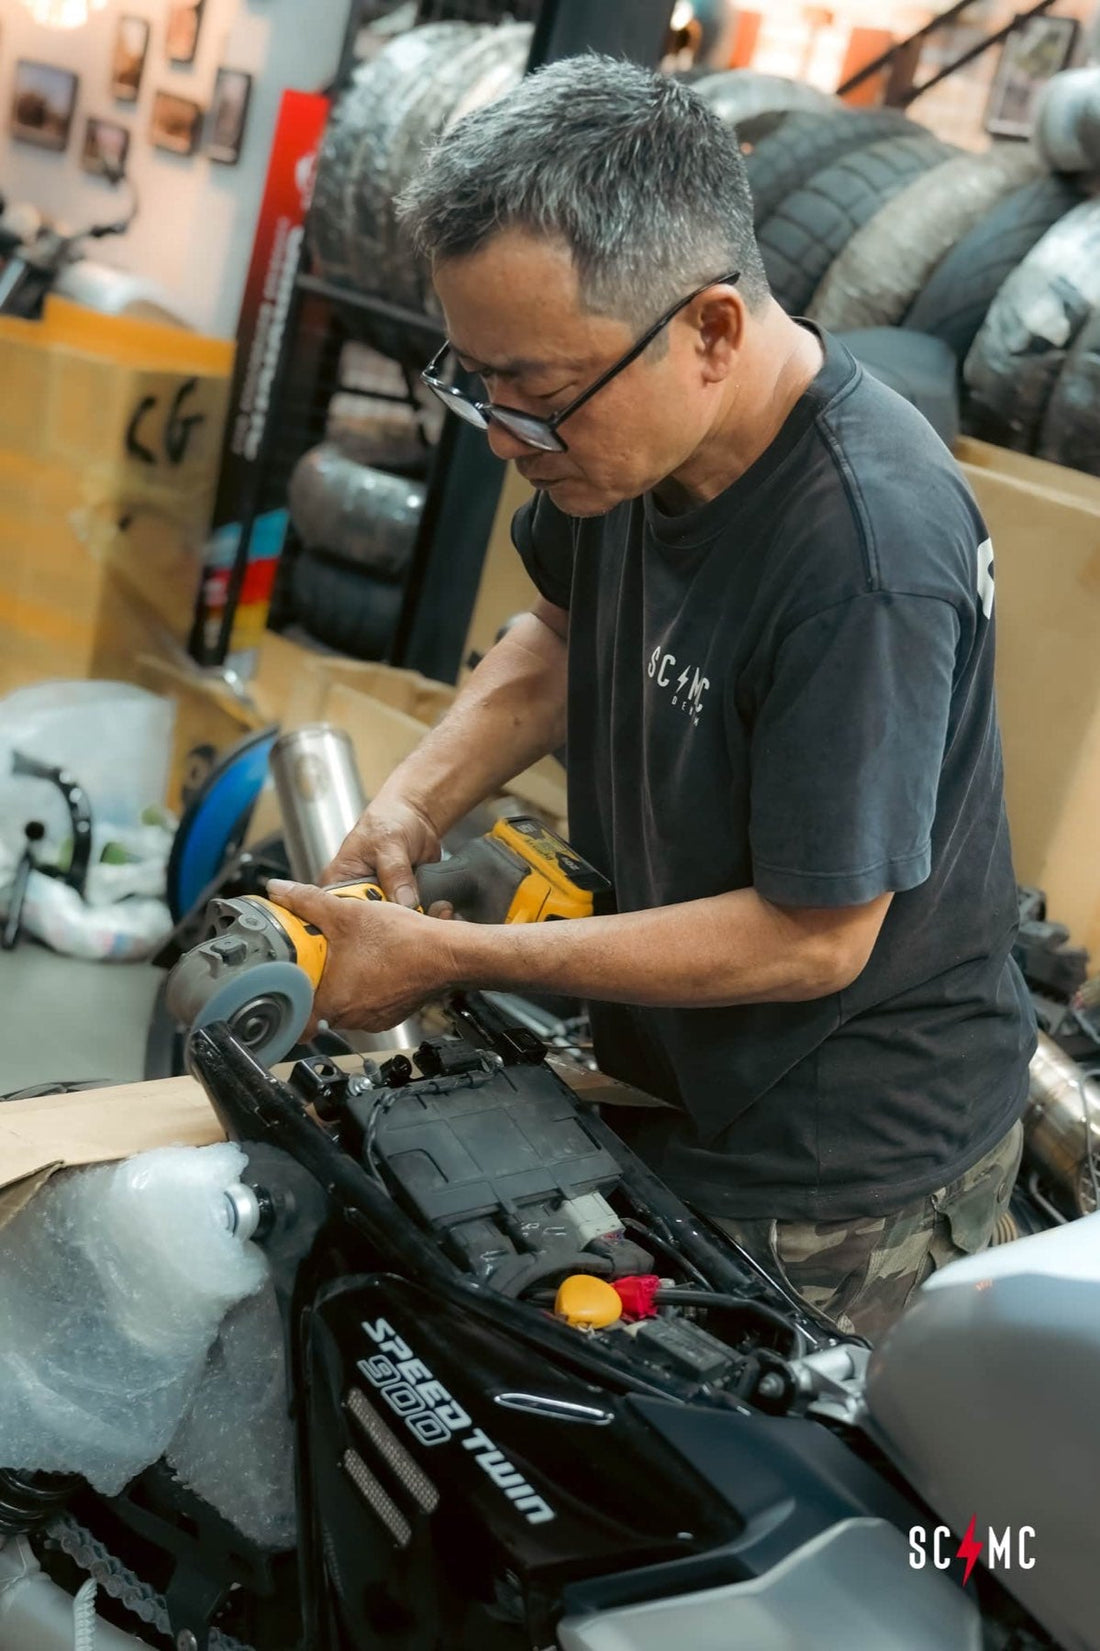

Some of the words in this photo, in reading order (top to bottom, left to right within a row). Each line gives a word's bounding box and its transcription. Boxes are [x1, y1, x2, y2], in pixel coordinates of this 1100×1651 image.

[356, 1354, 451, 1446] 900
[361, 1317, 472, 1430] SPEED
[461, 1427, 556, 1524] TWIN
